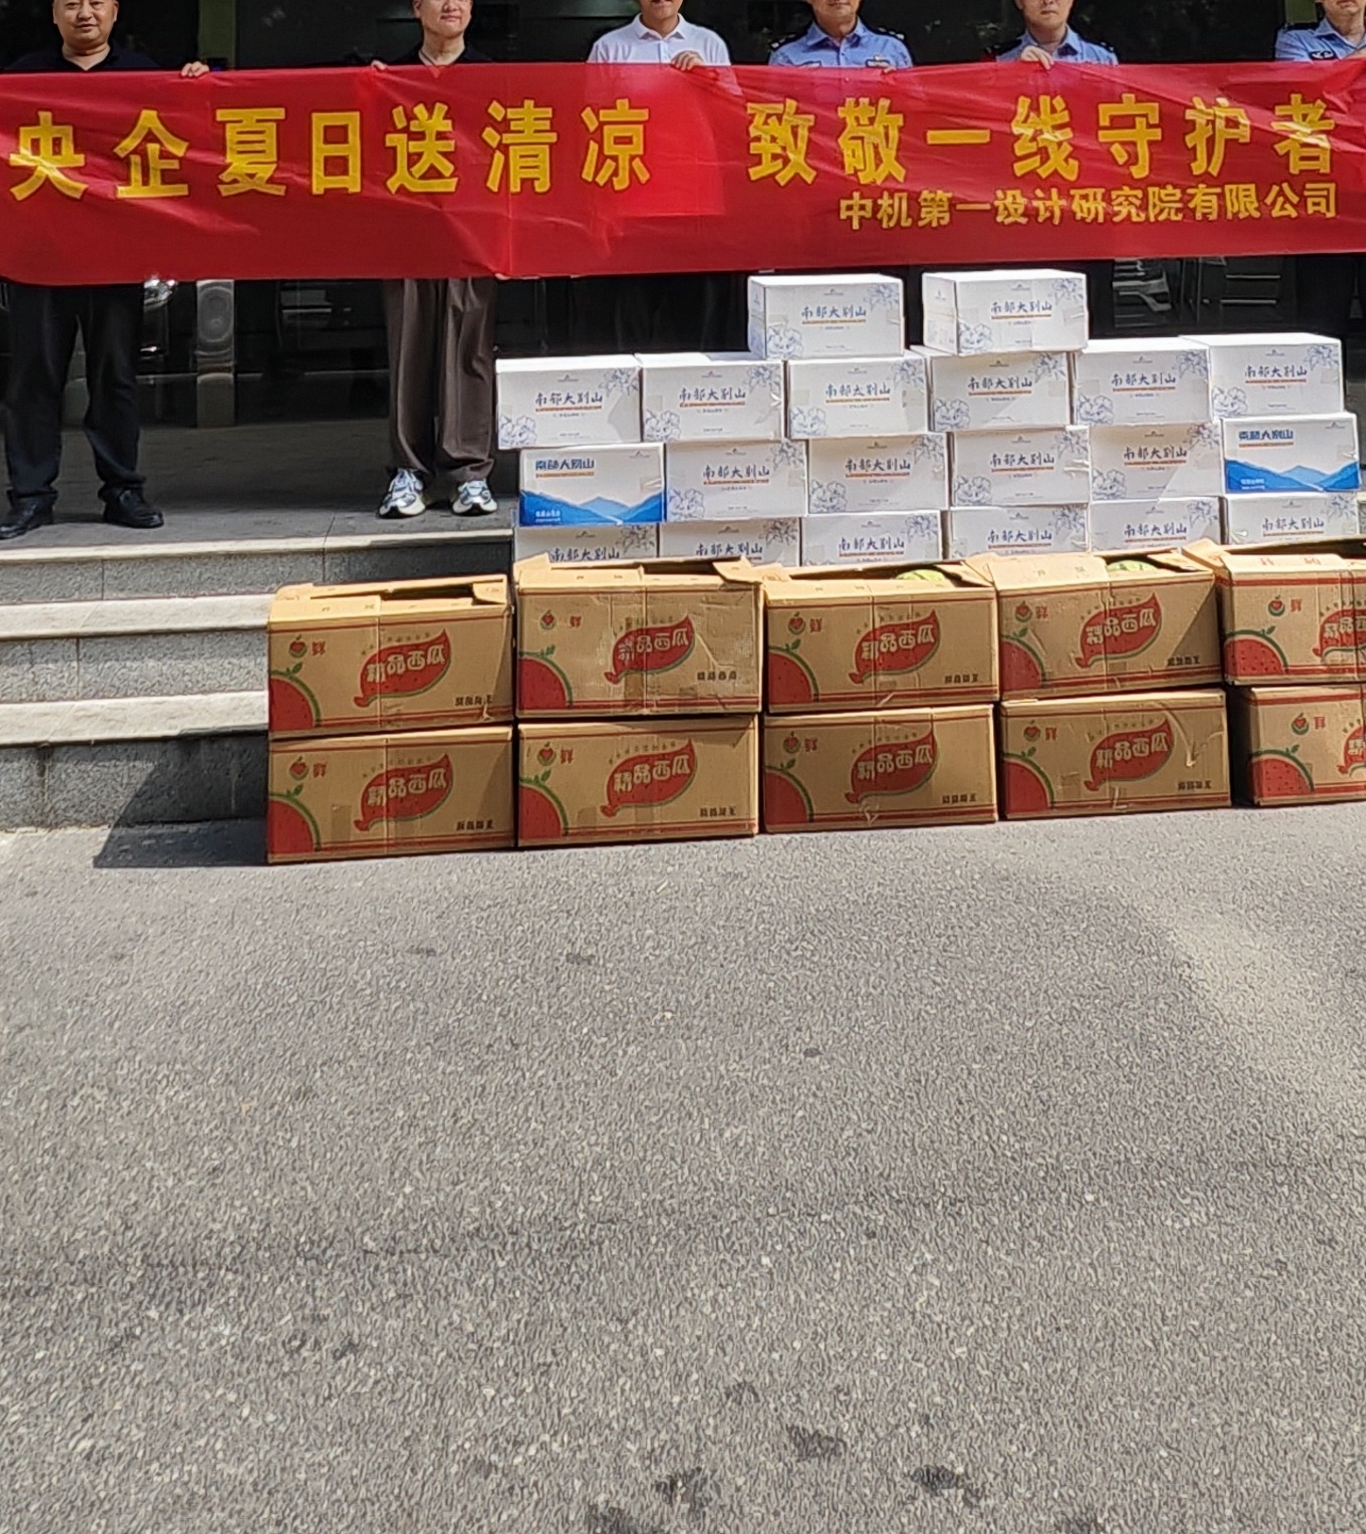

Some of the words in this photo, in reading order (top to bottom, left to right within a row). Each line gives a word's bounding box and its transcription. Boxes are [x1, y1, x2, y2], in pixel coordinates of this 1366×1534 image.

[9, 97, 649, 201] 央企夏日送清凉
[746, 93, 1336, 186] 致敬一线守护者
[840, 182, 1338, 231] 中机第一设计研究院有限公司
